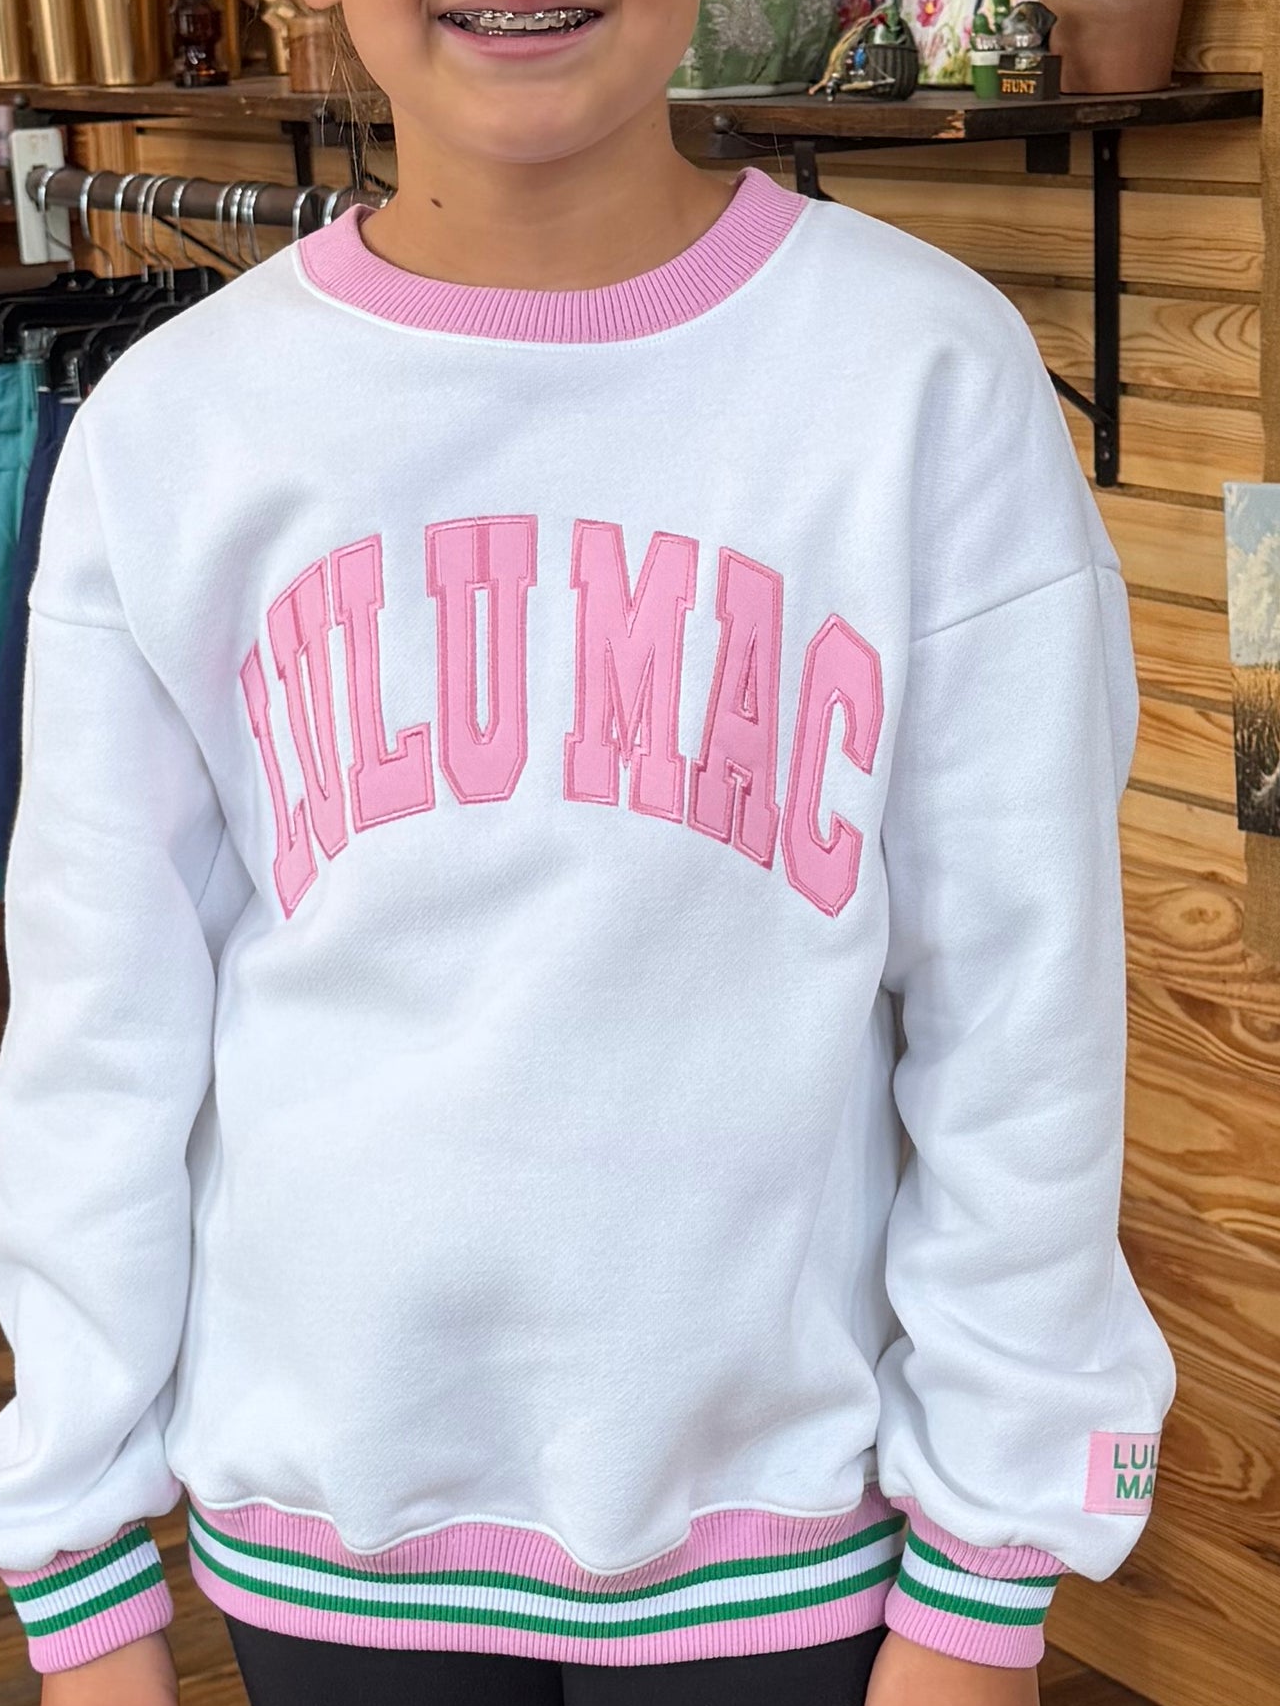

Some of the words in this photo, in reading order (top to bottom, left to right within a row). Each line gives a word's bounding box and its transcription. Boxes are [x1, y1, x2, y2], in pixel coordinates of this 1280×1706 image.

[1001, 78, 1037, 94] HUNT
[239, 514, 538, 919] LULU
[562, 518, 884, 919] MAC
